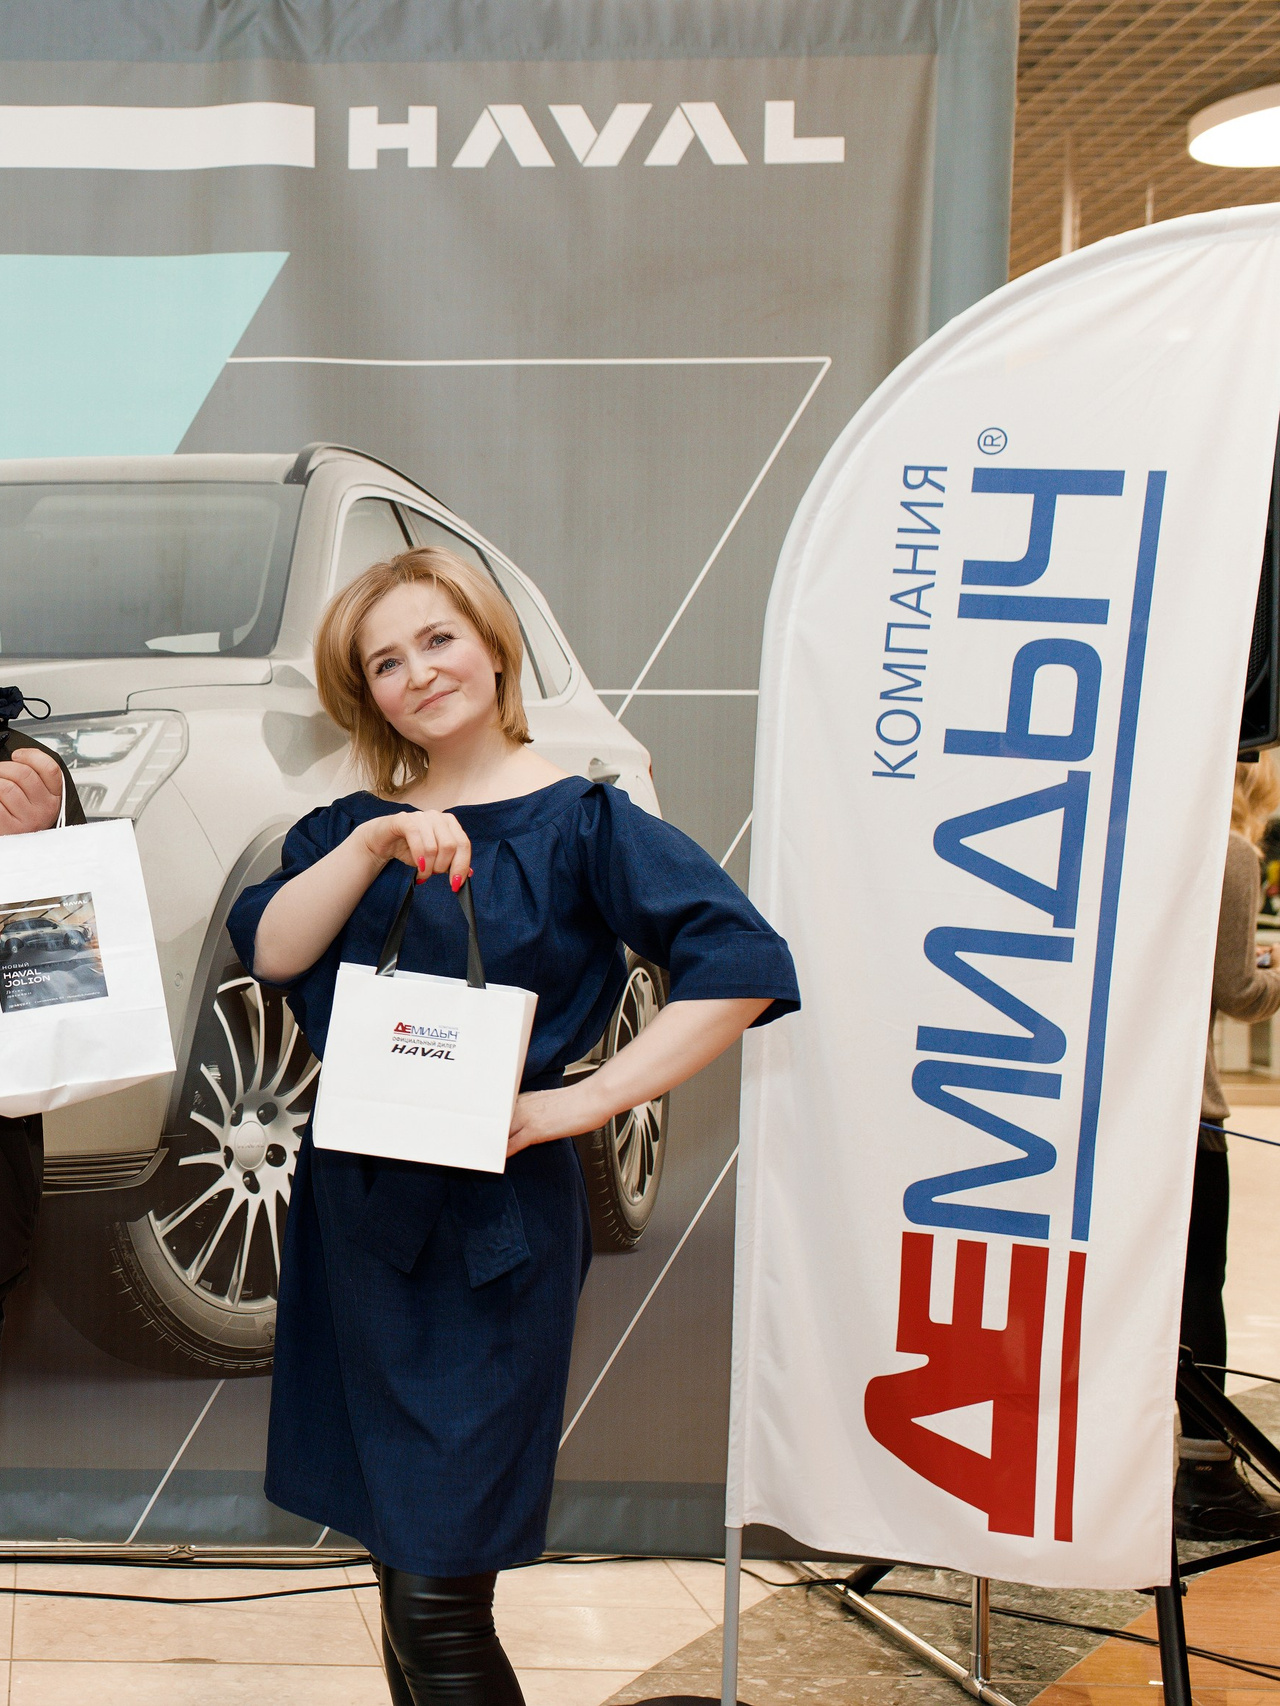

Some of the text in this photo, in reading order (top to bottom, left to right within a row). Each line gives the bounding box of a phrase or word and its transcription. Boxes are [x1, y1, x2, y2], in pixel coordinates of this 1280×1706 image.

[348, 100, 846, 169] HAVAL
[872, 465, 948, 779] КОМПАНИЯ
[3, 968, 42, 980] HAVAL
[5, 975, 51, 988] JOLION
[864, 467, 1125, 1538] ДЕМИДЫЧ
[393, 1021, 458, 1040] ДЕМИДЫЧ
[391, 1043, 456, 1061] HAVAL
[392, 1036, 457, 1050] ОФИЦИАЛЬНЫЙ ДИЛЕР
